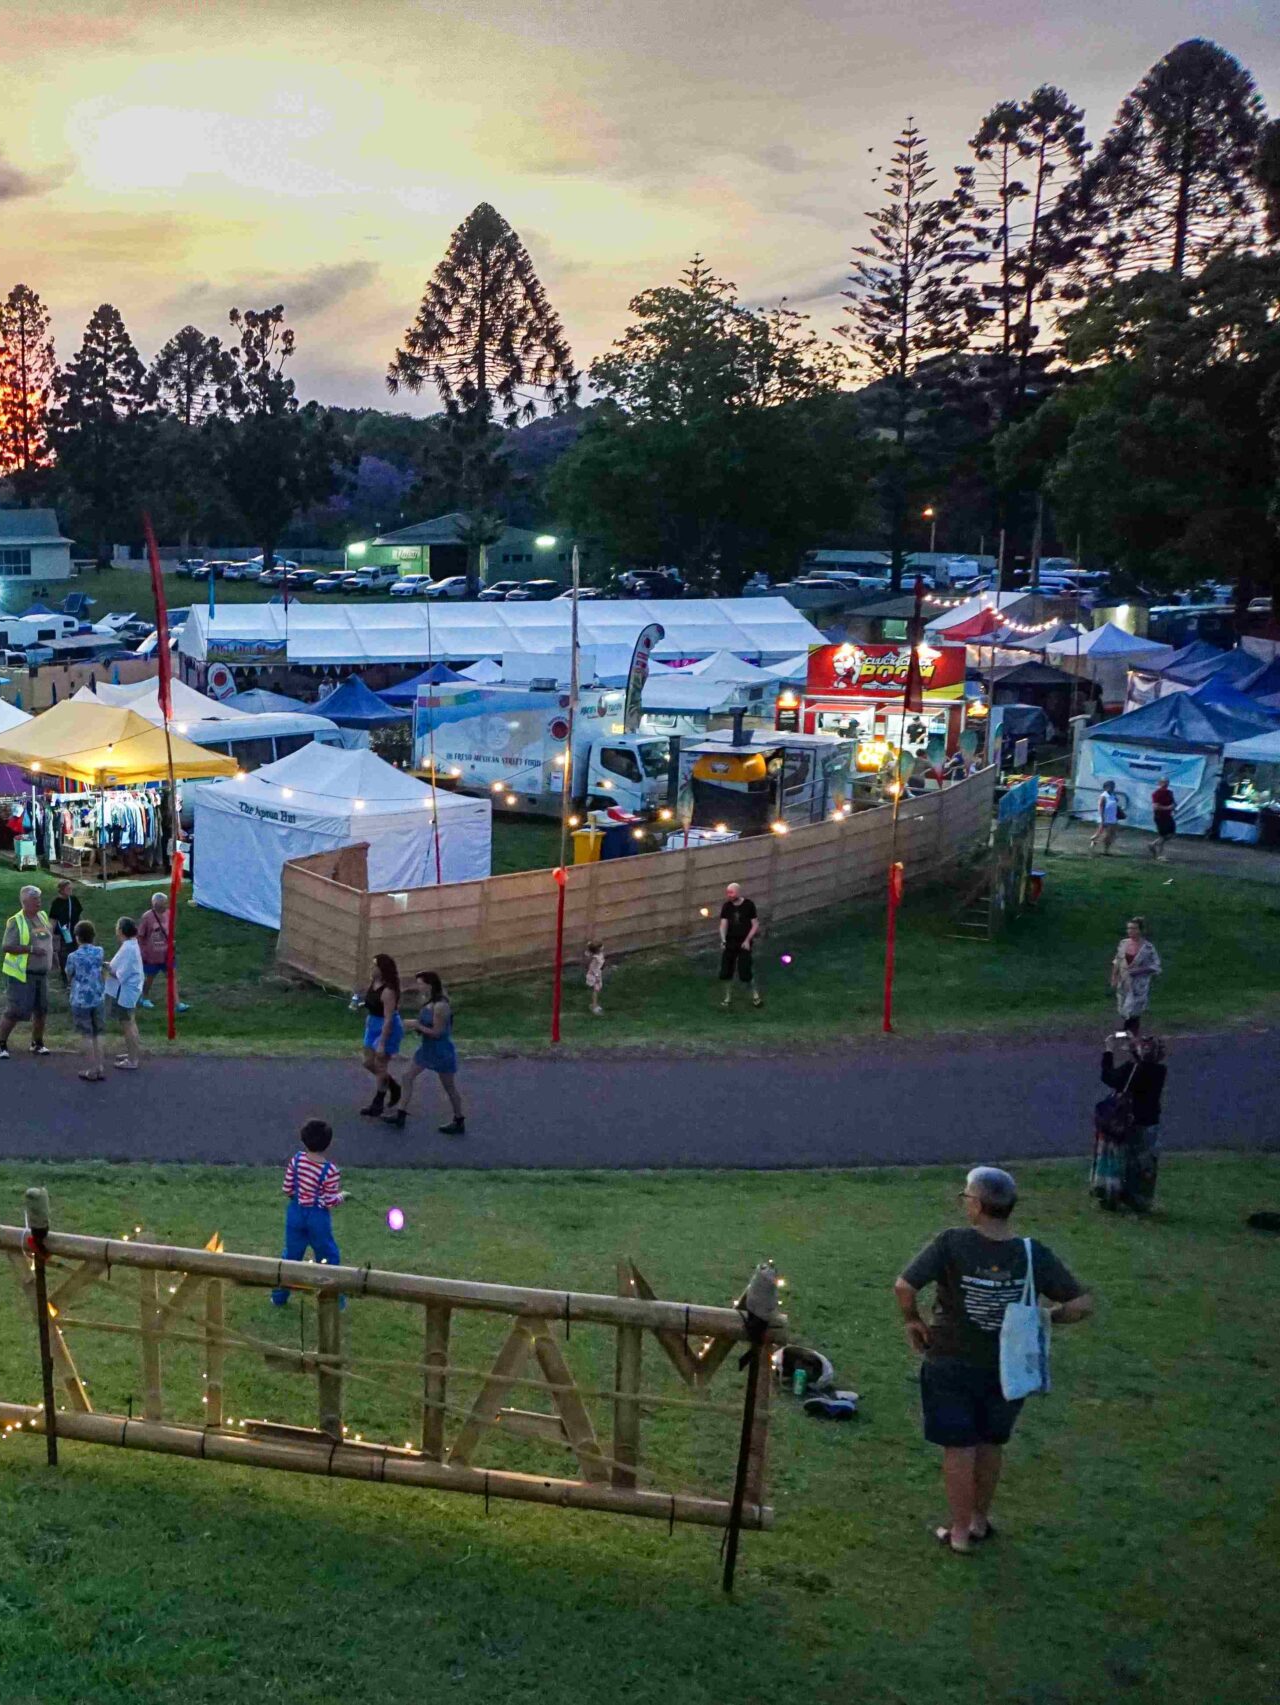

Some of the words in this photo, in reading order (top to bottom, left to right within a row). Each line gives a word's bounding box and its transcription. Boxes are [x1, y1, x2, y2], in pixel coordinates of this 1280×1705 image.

[860, 664, 936, 684] BOOM
[473, 754, 500, 763] MEXICAN
[501, 756, 523, 765] STREET
[524, 759, 541, 767] FOOD
[239, 801, 254, 814] The
[280, 810, 296, 823] Hut
